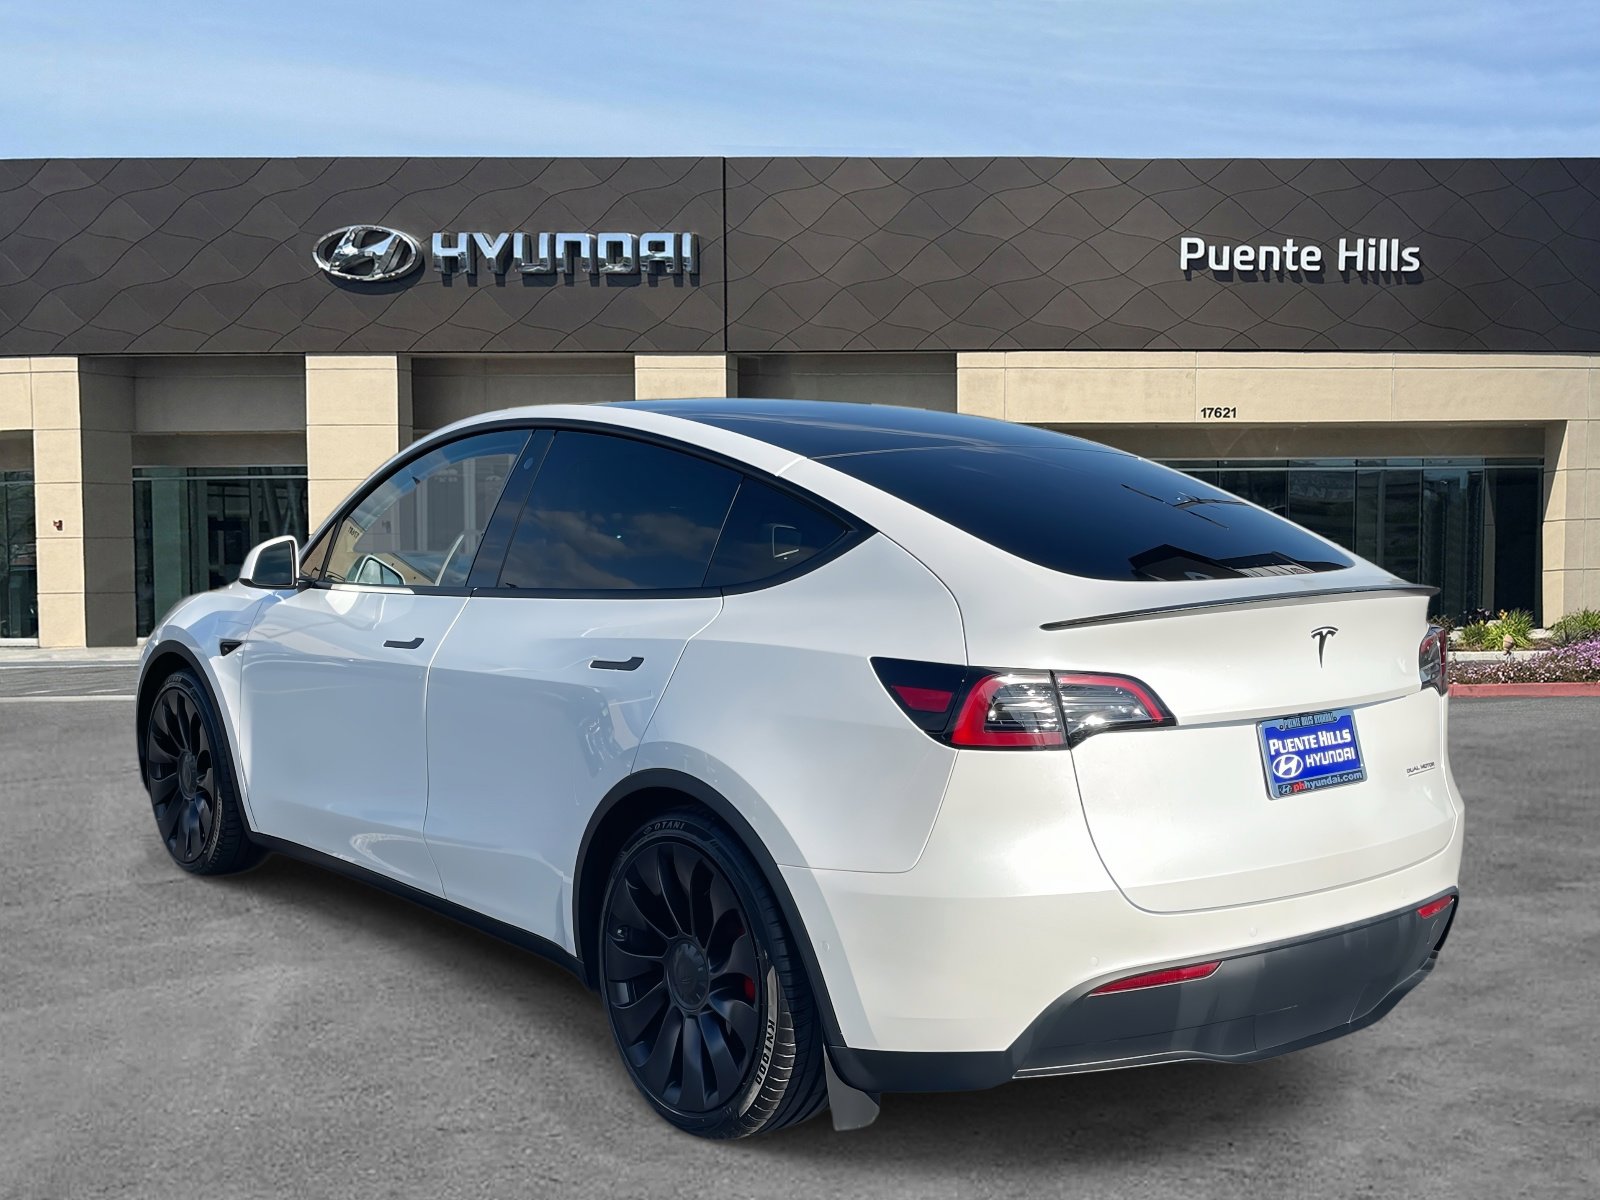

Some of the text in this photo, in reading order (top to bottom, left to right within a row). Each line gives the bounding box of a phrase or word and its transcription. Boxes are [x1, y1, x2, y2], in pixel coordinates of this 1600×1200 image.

[432, 232, 699, 275] HYUNDAI
[1180, 237, 1420, 272] Puente Hills
[1200, 407, 1237, 418] 17621
[1269, 729, 1352, 755] PUENTE HILLS
[1305, 747, 1356, 767] HYUNDAI
[1406, 765, 1420, 774] DUAL
[1293, 772, 1363, 792] phhyundai.com
[654, 820, 687, 831] OTANI
